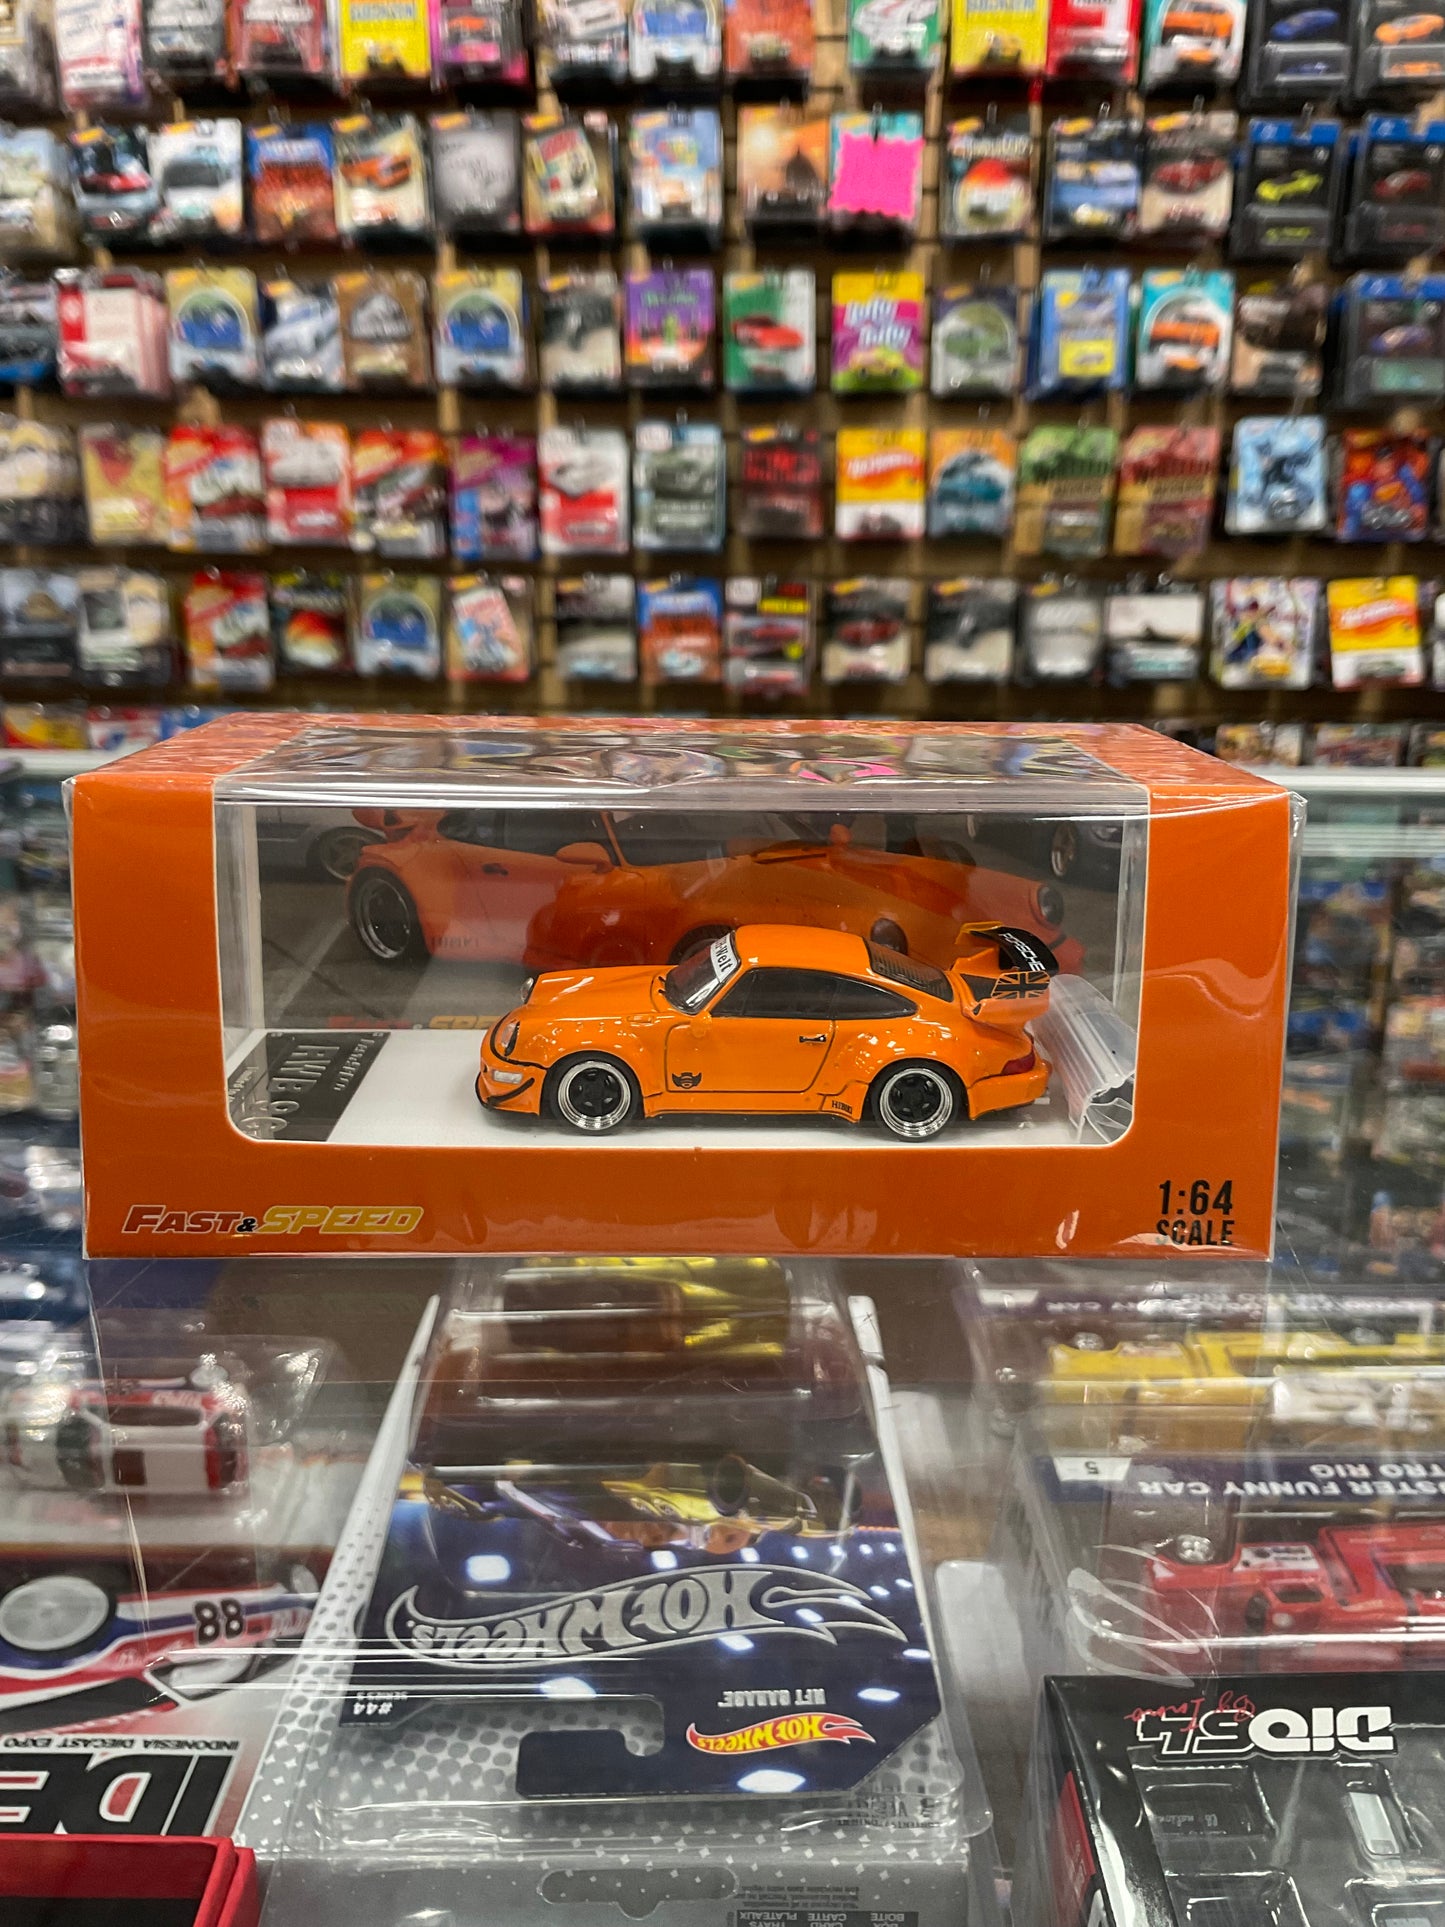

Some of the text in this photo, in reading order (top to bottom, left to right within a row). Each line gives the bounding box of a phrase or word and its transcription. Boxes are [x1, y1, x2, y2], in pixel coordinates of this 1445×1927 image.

[998, 932, 1046, 971] PORSCHE
[1159, 1180, 1233, 1215] 1:64
[1156, 1219, 1235, 1246] SCALE
[1085, 1460, 1101, 1476] 5
[1310, 1463, 1369, 1478] RIG
[1138, 1481, 1211, 1496] CAR
[1224, 1481, 1342, 1496] FUNNY
[193, 1598, 245, 1645] 88
[353, 1702, 394, 1715] #44
[3, 1737, 240, 1751] INDONESIA DIECAST EXPO
[739, 1911, 798, 1922] PLATEAUX
[808, 1912, 847, 1922] CARTE
